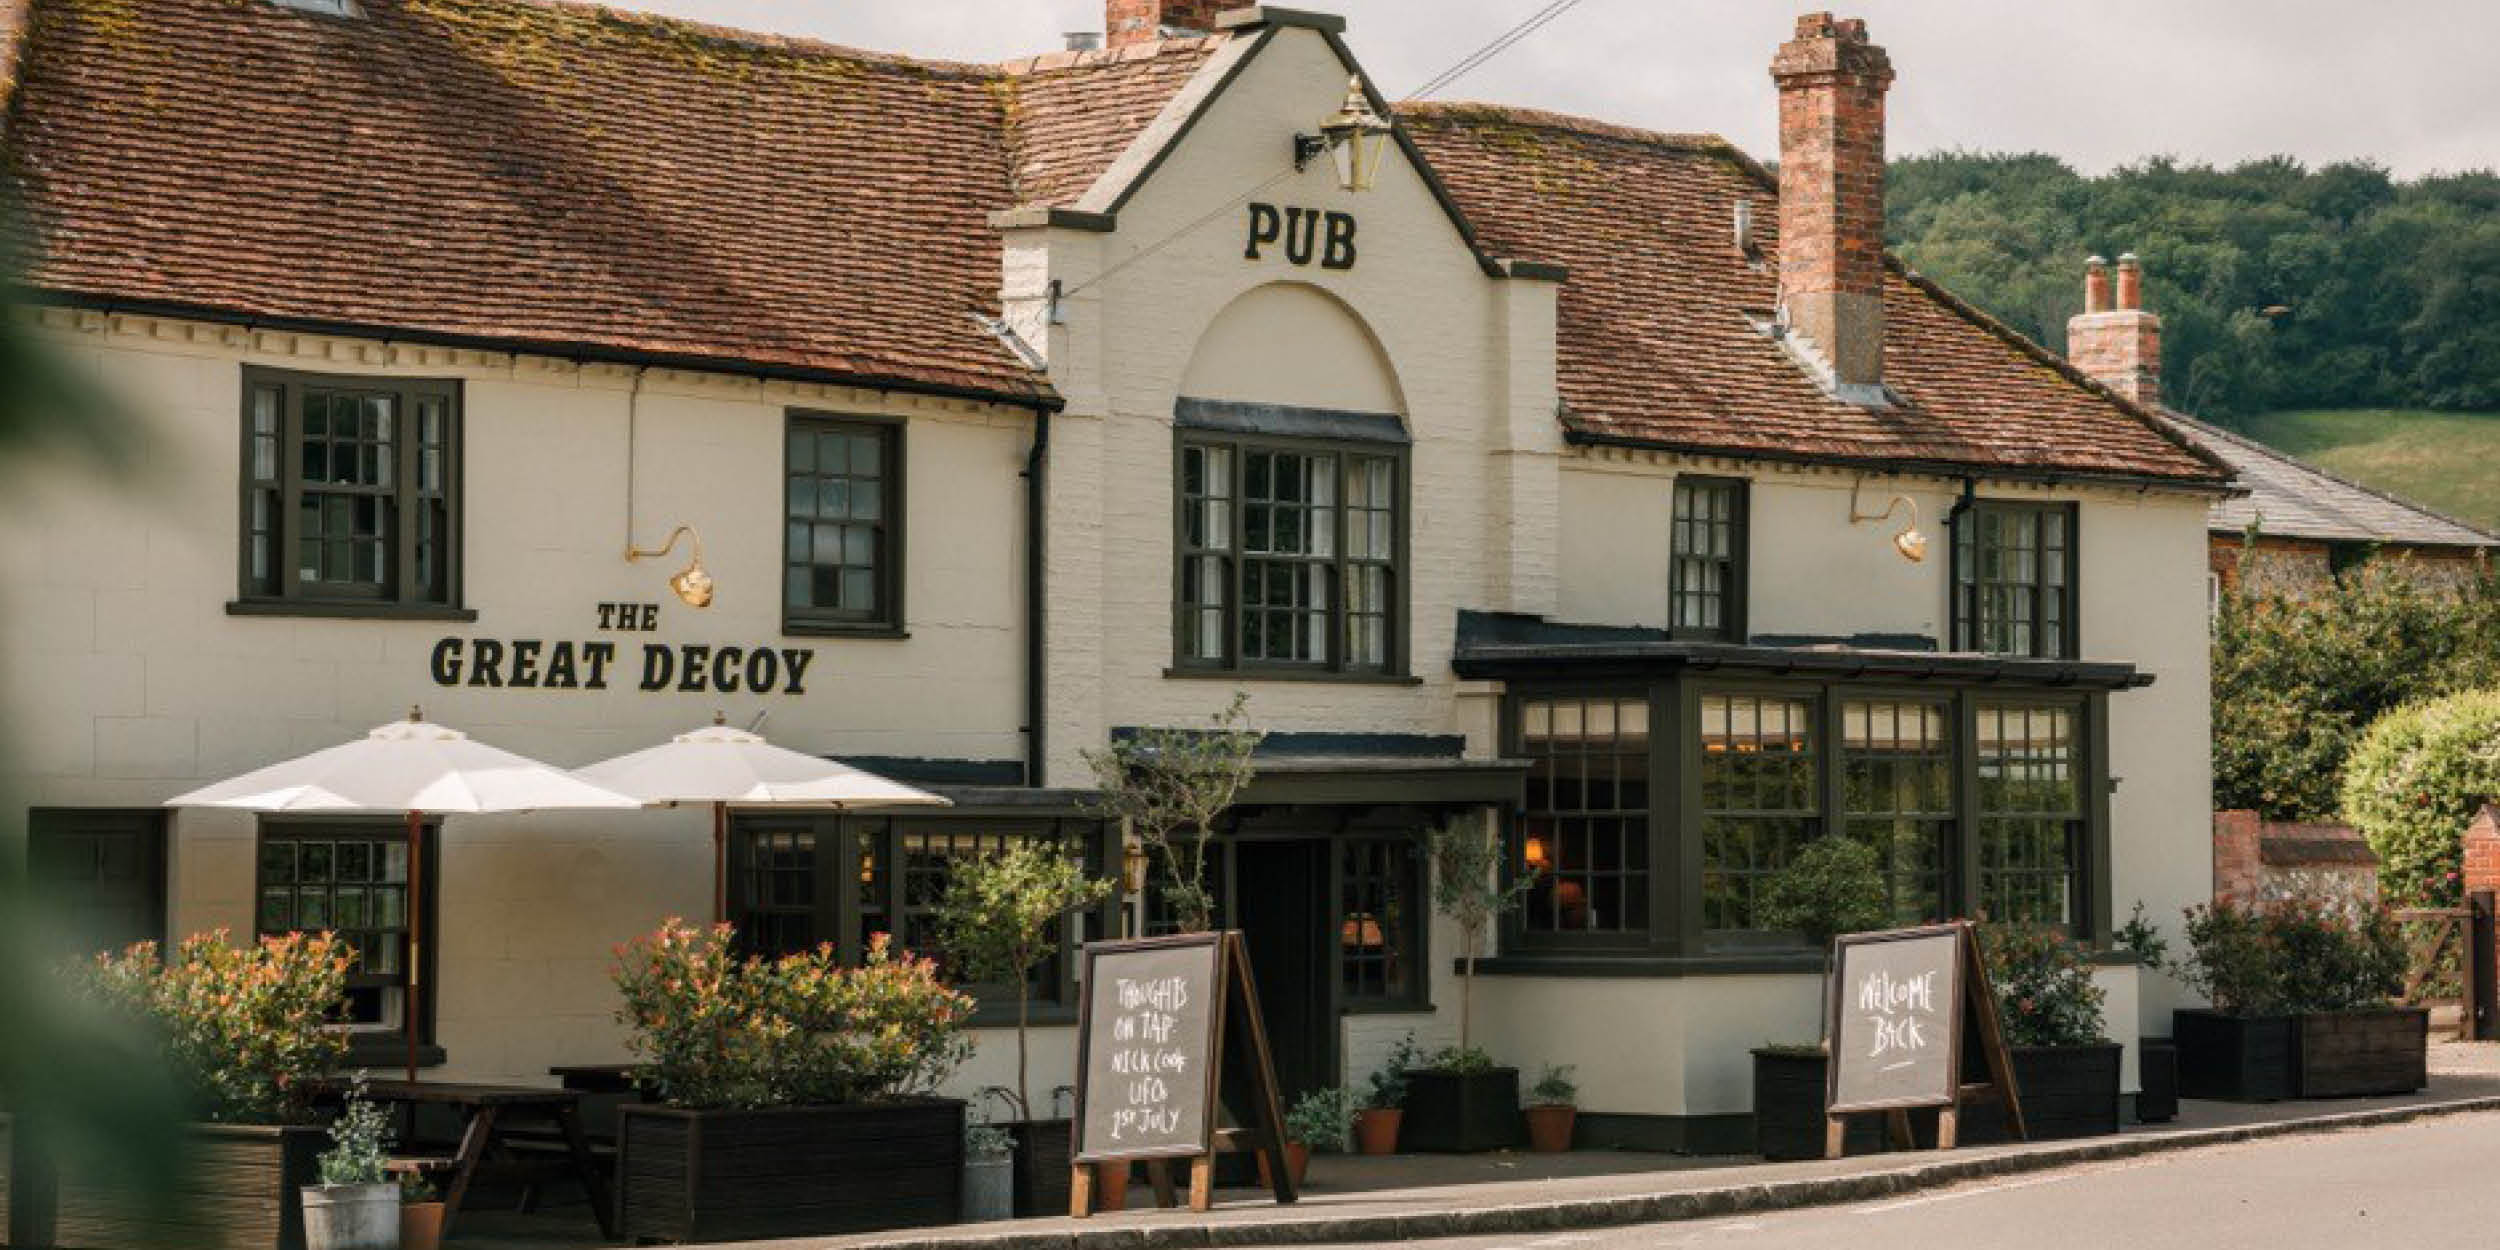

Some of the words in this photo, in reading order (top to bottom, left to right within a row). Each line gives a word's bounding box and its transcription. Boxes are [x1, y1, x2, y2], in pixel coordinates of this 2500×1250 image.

[1244, 202, 1356, 269] PUB
[598, 603, 658, 632] THE
[431, 637, 615, 688] GREAT
[639, 644, 814, 695] DECOY
[1858, 970, 1936, 1014] WELCOME
[1114, 1016, 1134, 1041] ON
[1865, 1015, 1926, 1058] BACK
[1111, 1048, 1150, 1073] NICK
[1138, 1106, 1180, 1134] JULY
